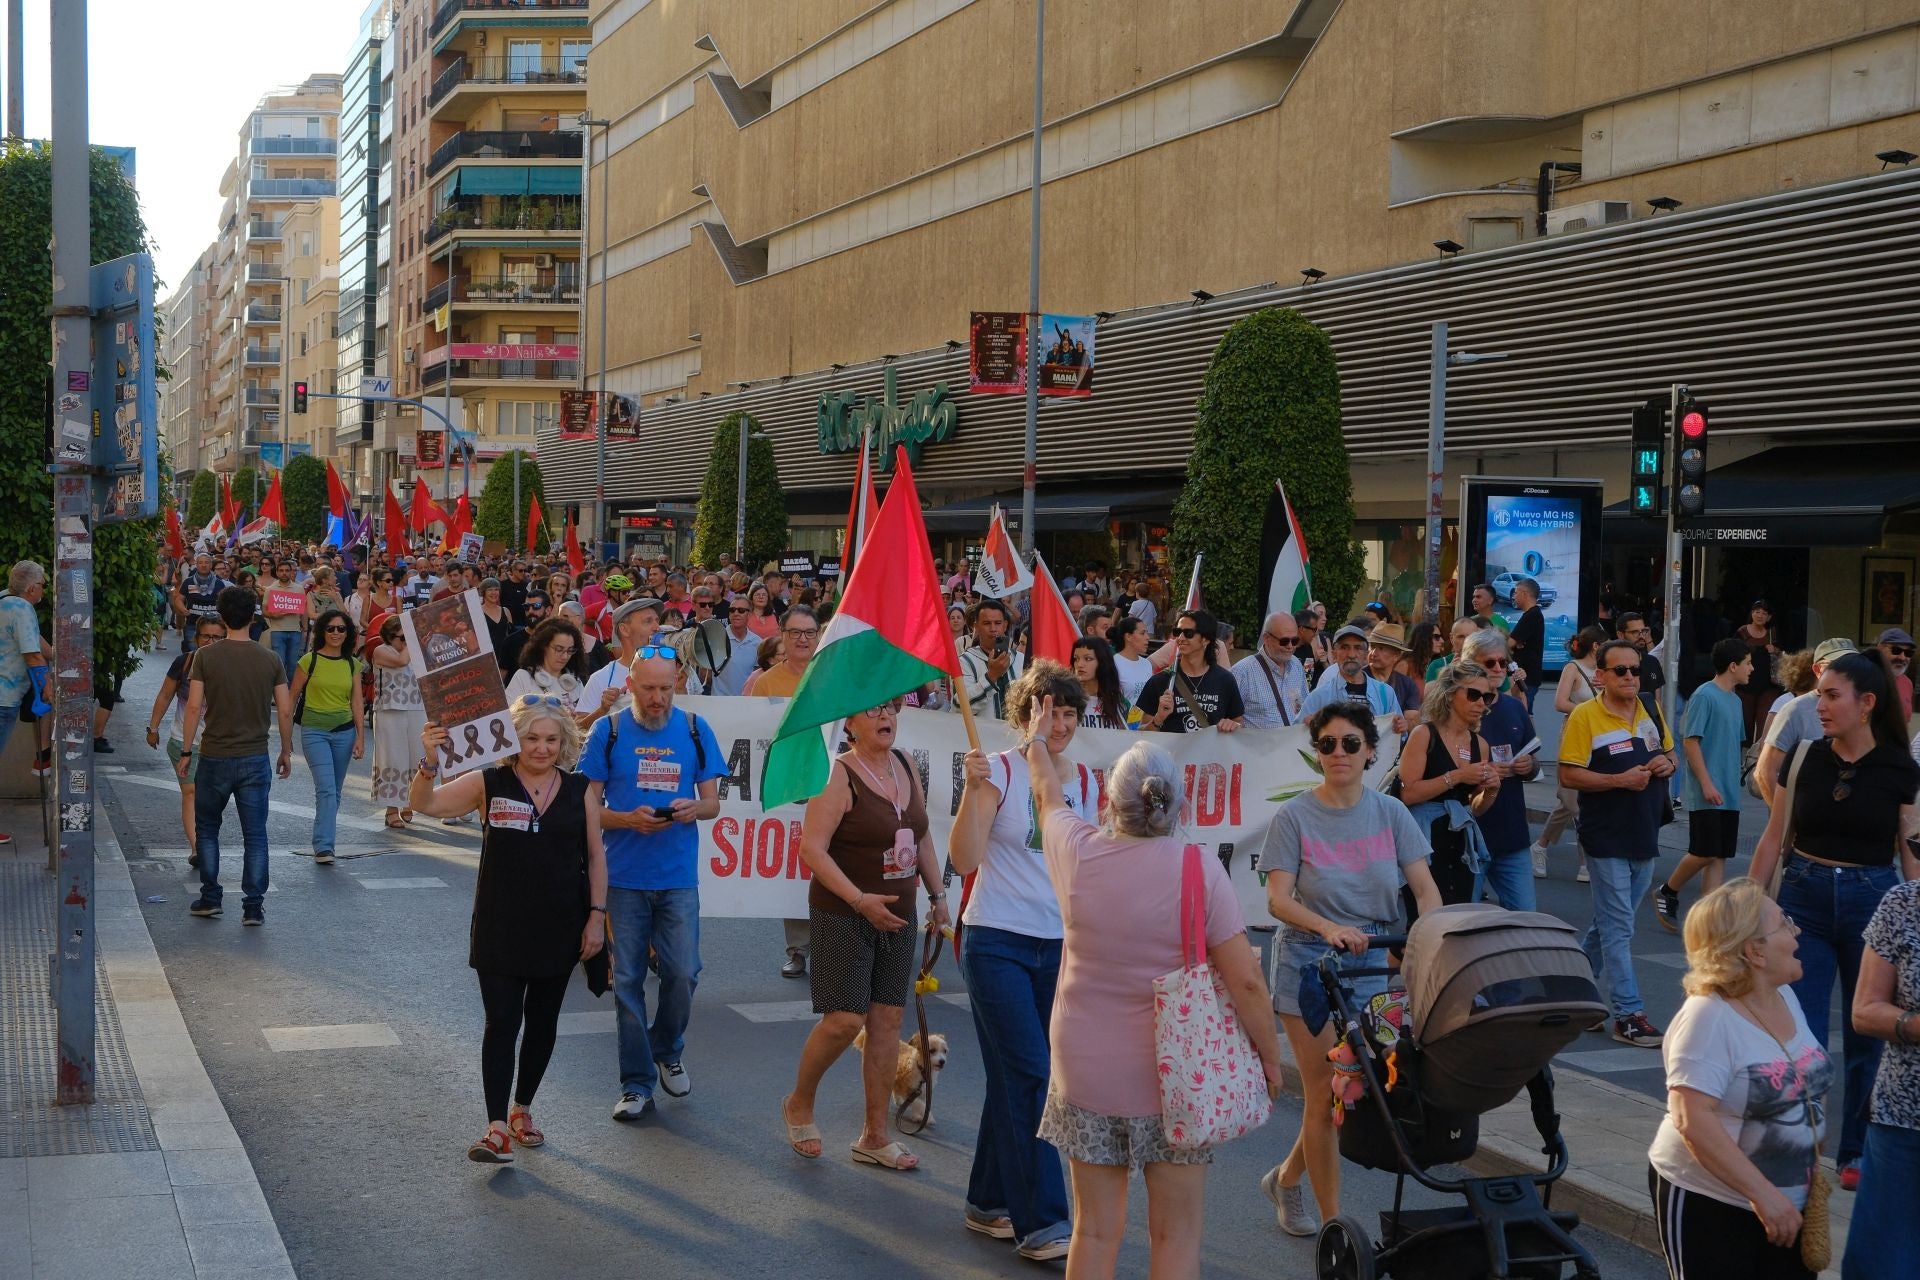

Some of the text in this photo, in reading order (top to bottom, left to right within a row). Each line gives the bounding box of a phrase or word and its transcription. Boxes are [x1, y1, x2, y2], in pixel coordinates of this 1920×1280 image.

[516, 346, 544, 359] Nails
[1052, 371, 1077, 382] MANÁ
[609, 427, 636, 435] AMARAL
[1640, 451, 1657, 474] 14
[1513, 510, 1575, 519] Nuevo MG HS
[1518, 518, 1575, 529] MÁS HYBRID
[783, 557, 809, 565] MAZÓN
[273, 594, 302, 605] Volem
[273, 602, 300, 611] votar.
[431, 636, 460, 655] MAZÓN
[435, 645, 469, 664] PRISIÓN
